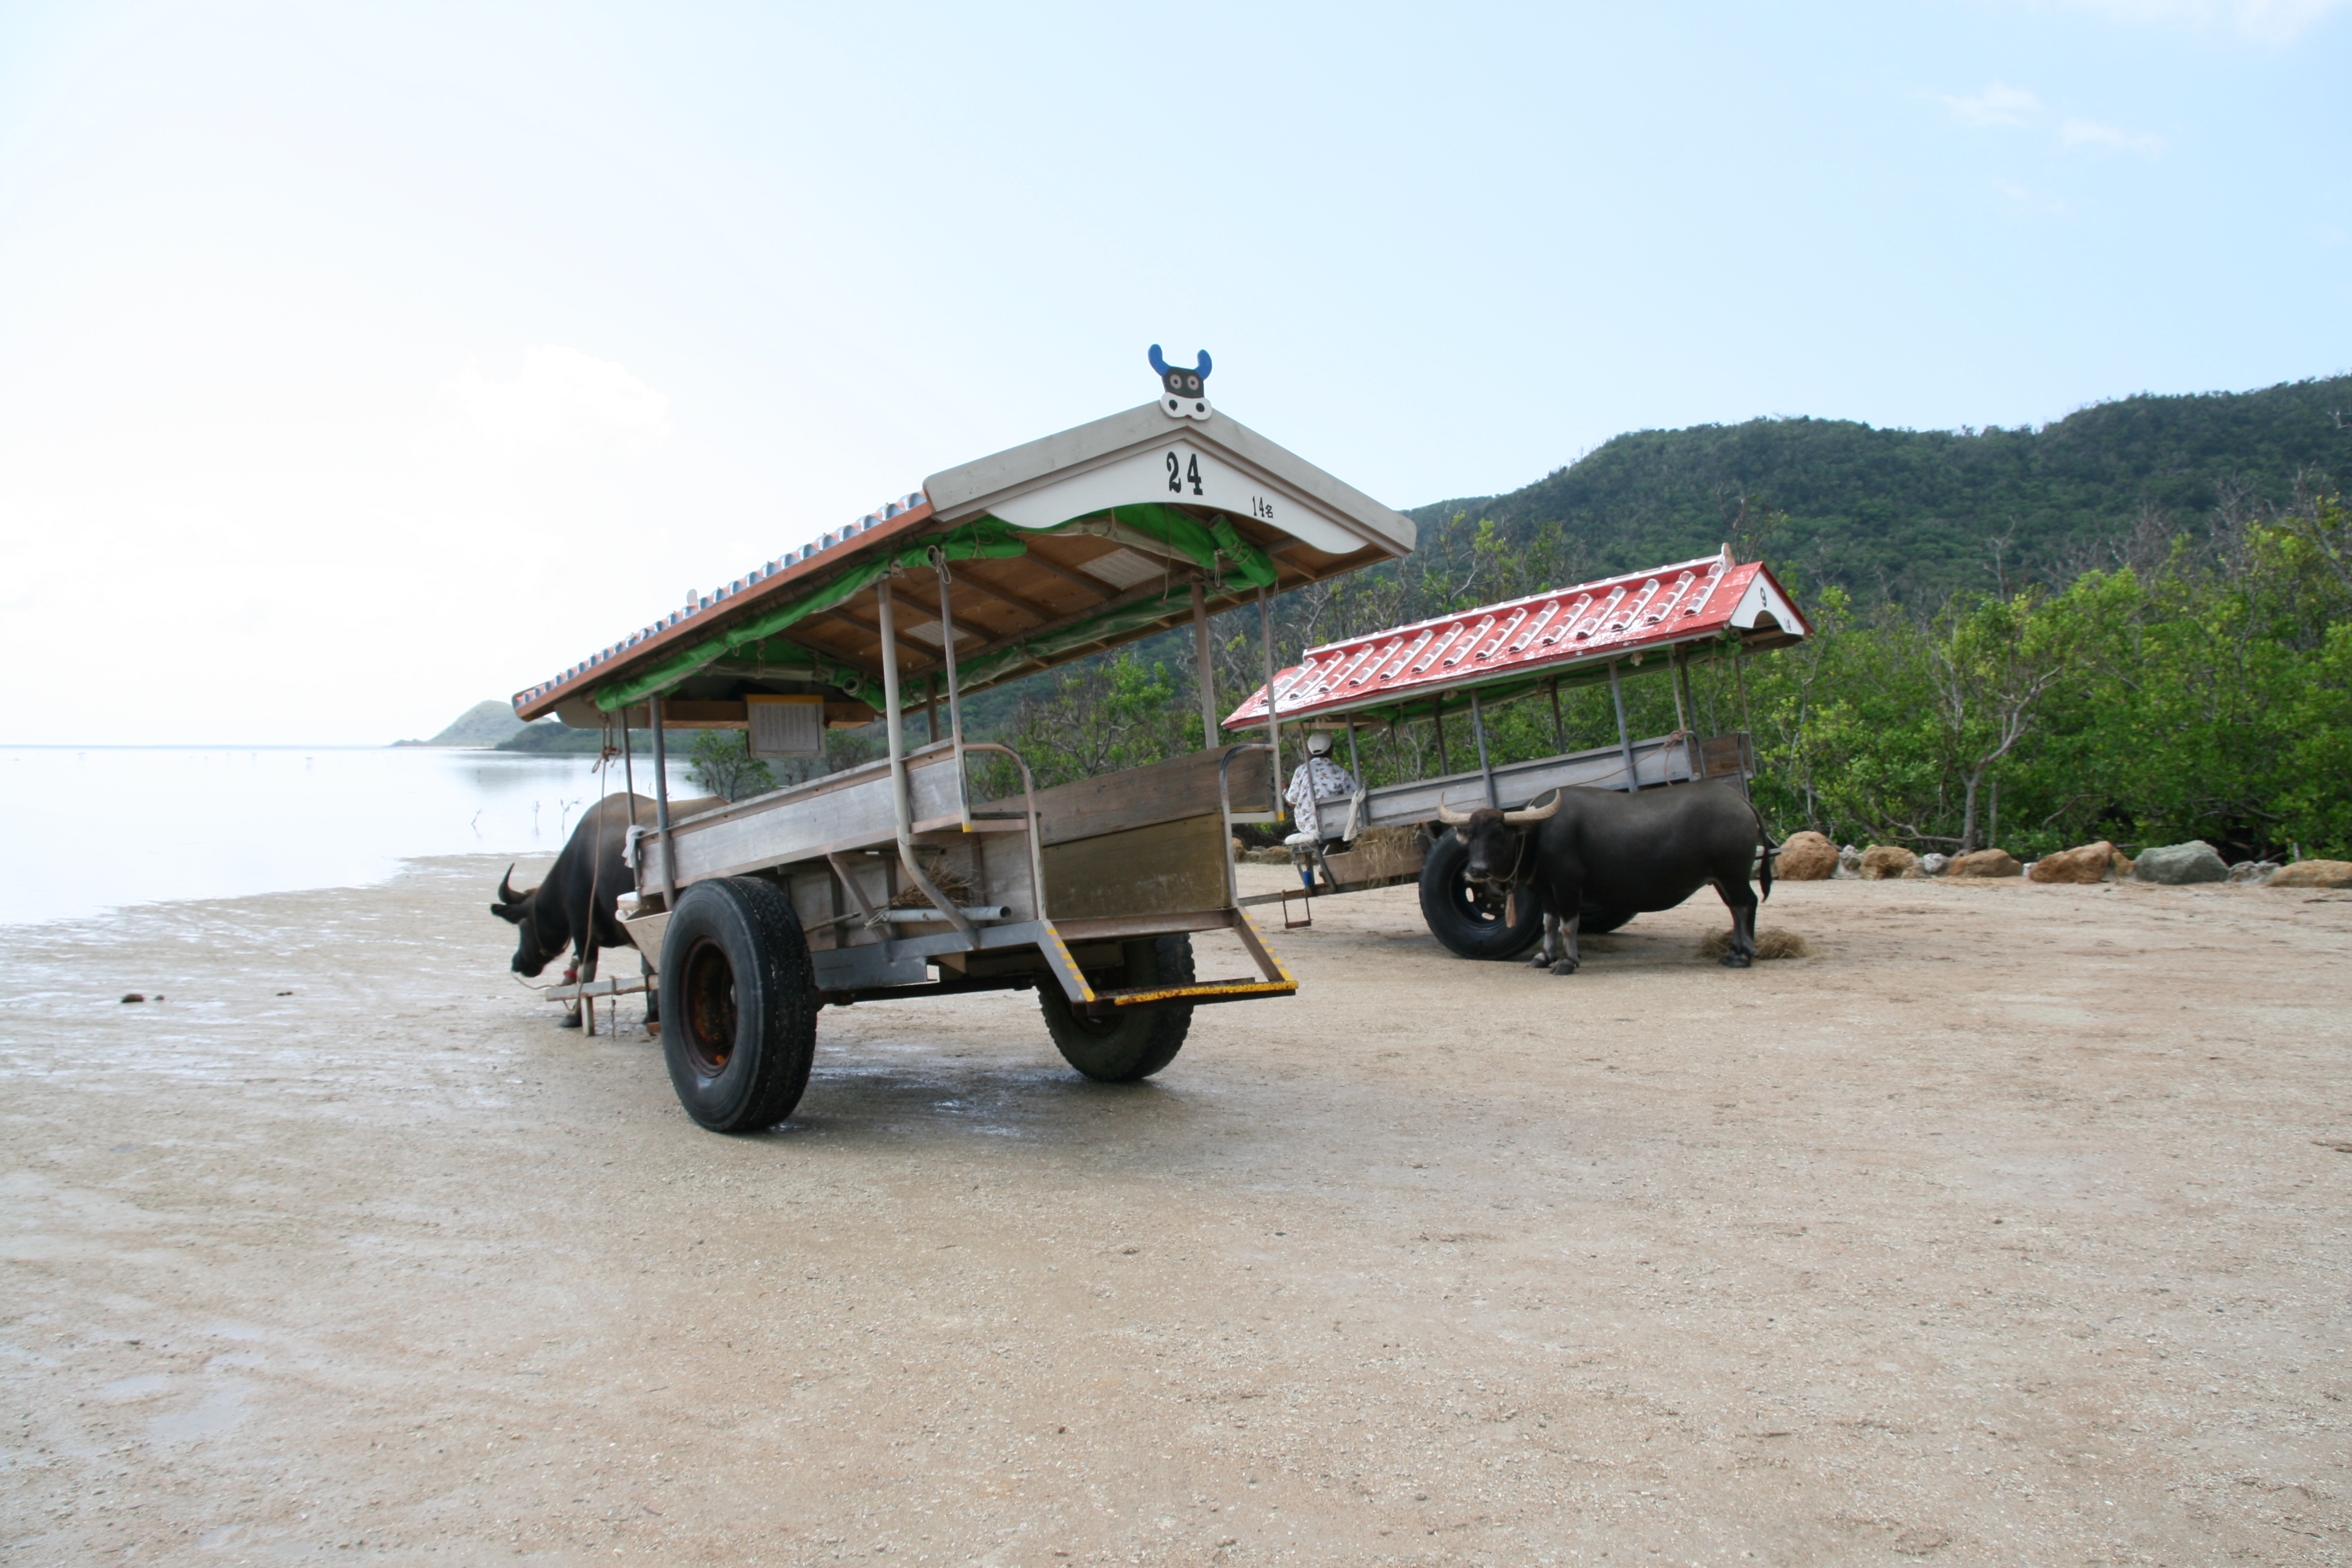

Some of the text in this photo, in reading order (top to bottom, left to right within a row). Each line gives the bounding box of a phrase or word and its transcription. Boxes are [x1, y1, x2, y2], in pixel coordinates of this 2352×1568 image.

[1166, 451, 1203, 495] 24
[1252, 495, 1273, 518] 14名
[1760, 587, 1767, 607] 9
